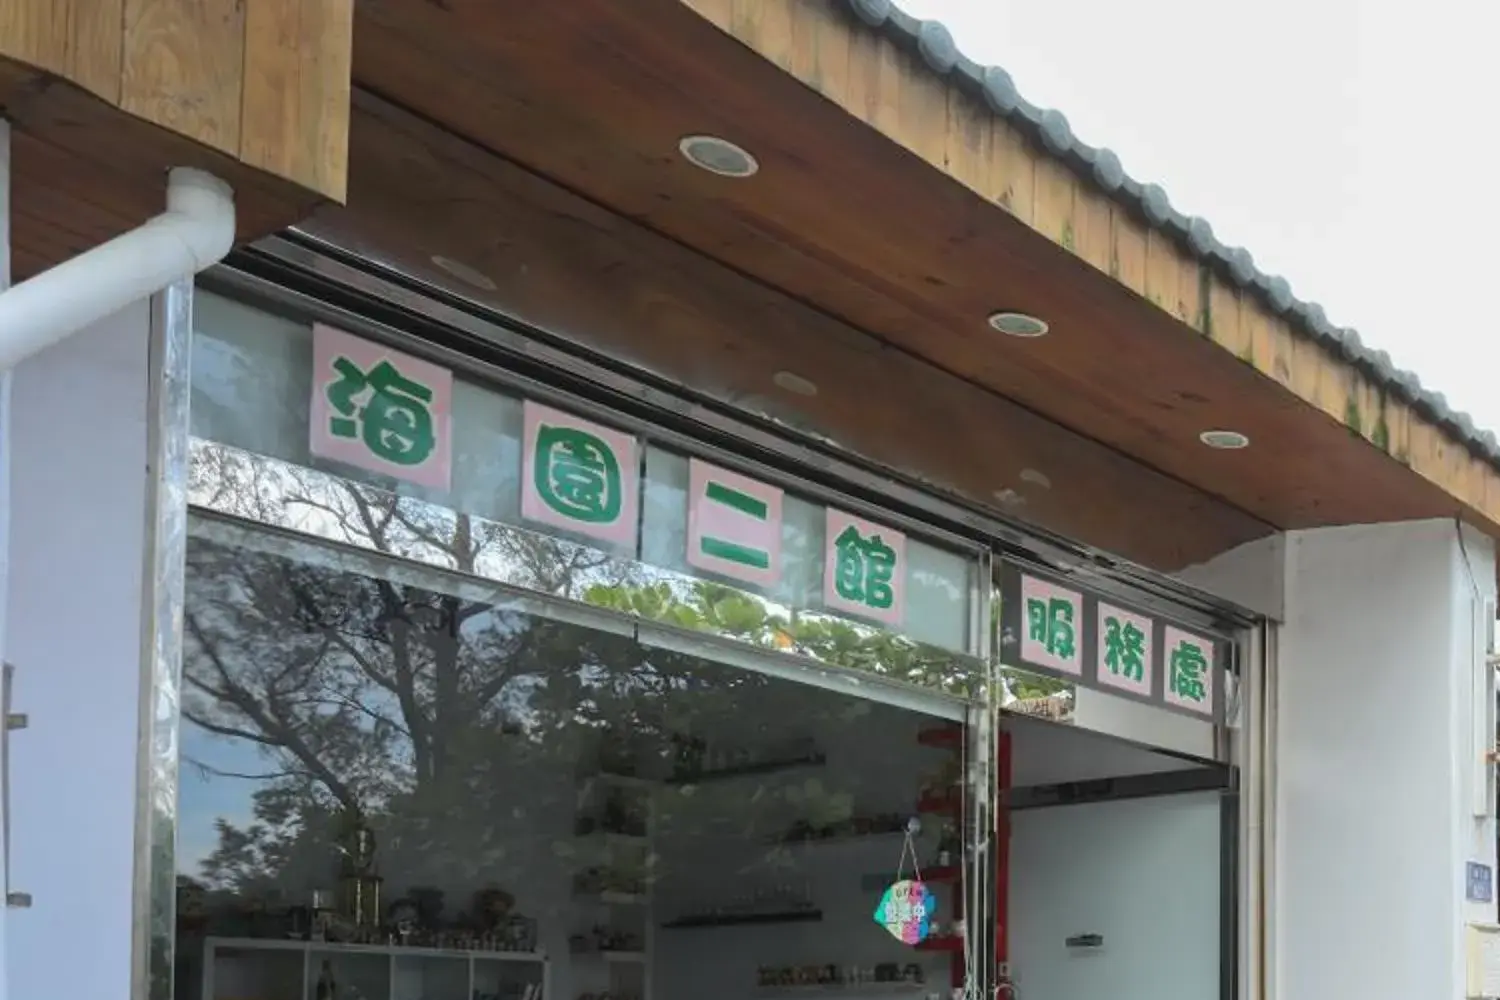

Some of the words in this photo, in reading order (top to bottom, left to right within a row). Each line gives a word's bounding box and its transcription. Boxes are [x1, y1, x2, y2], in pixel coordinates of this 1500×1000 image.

[324, 356, 897, 610] 海園二館
[1027, 597, 1209, 702] 服務處
